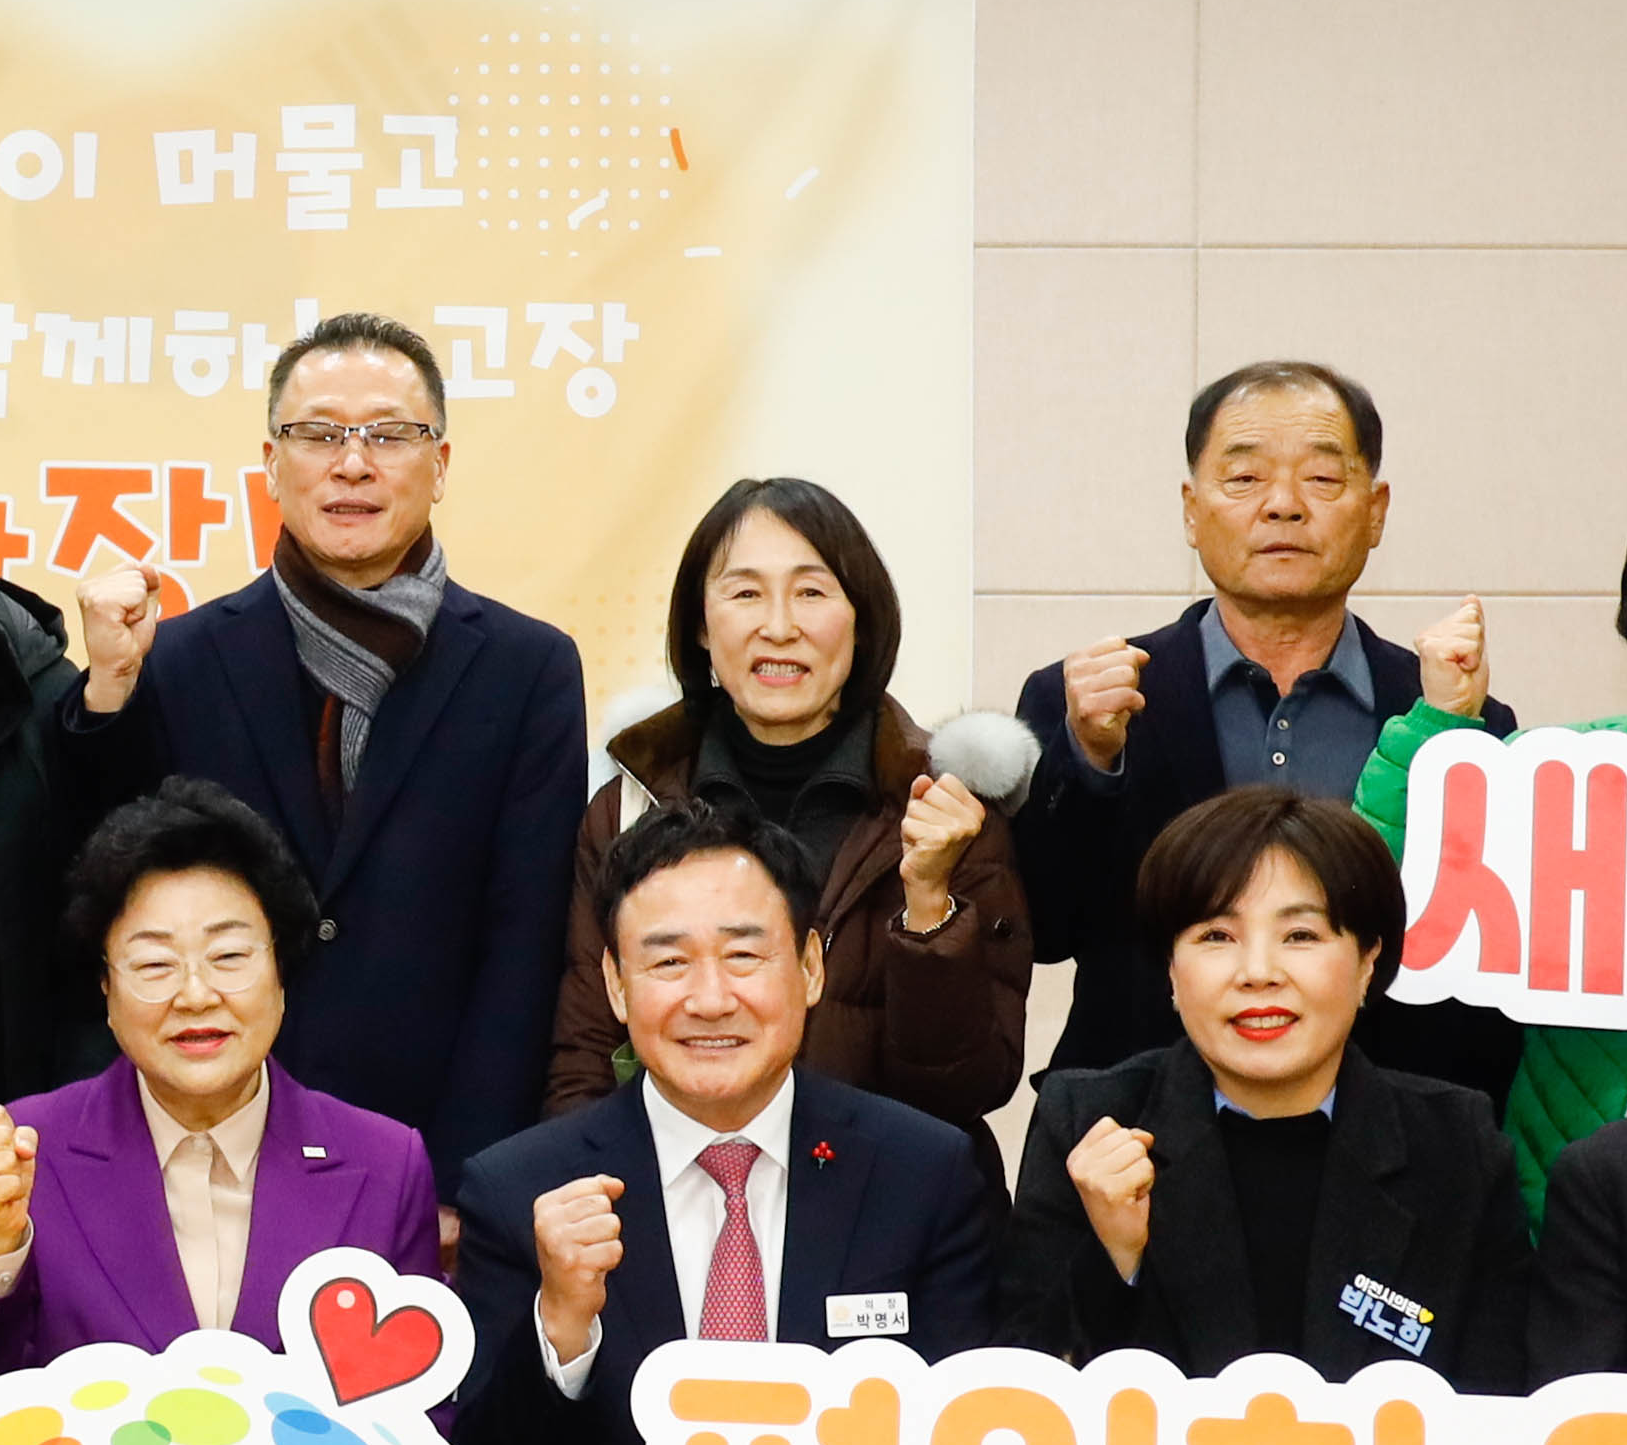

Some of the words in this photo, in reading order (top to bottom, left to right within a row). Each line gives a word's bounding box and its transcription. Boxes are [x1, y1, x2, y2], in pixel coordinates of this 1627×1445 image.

[154, 103, 464, 231] 머물고
[434, 300, 639, 418] 고장
[857, 1311, 905, 1330] 박명서
[1338, 1283, 1432, 1357] 박노희
